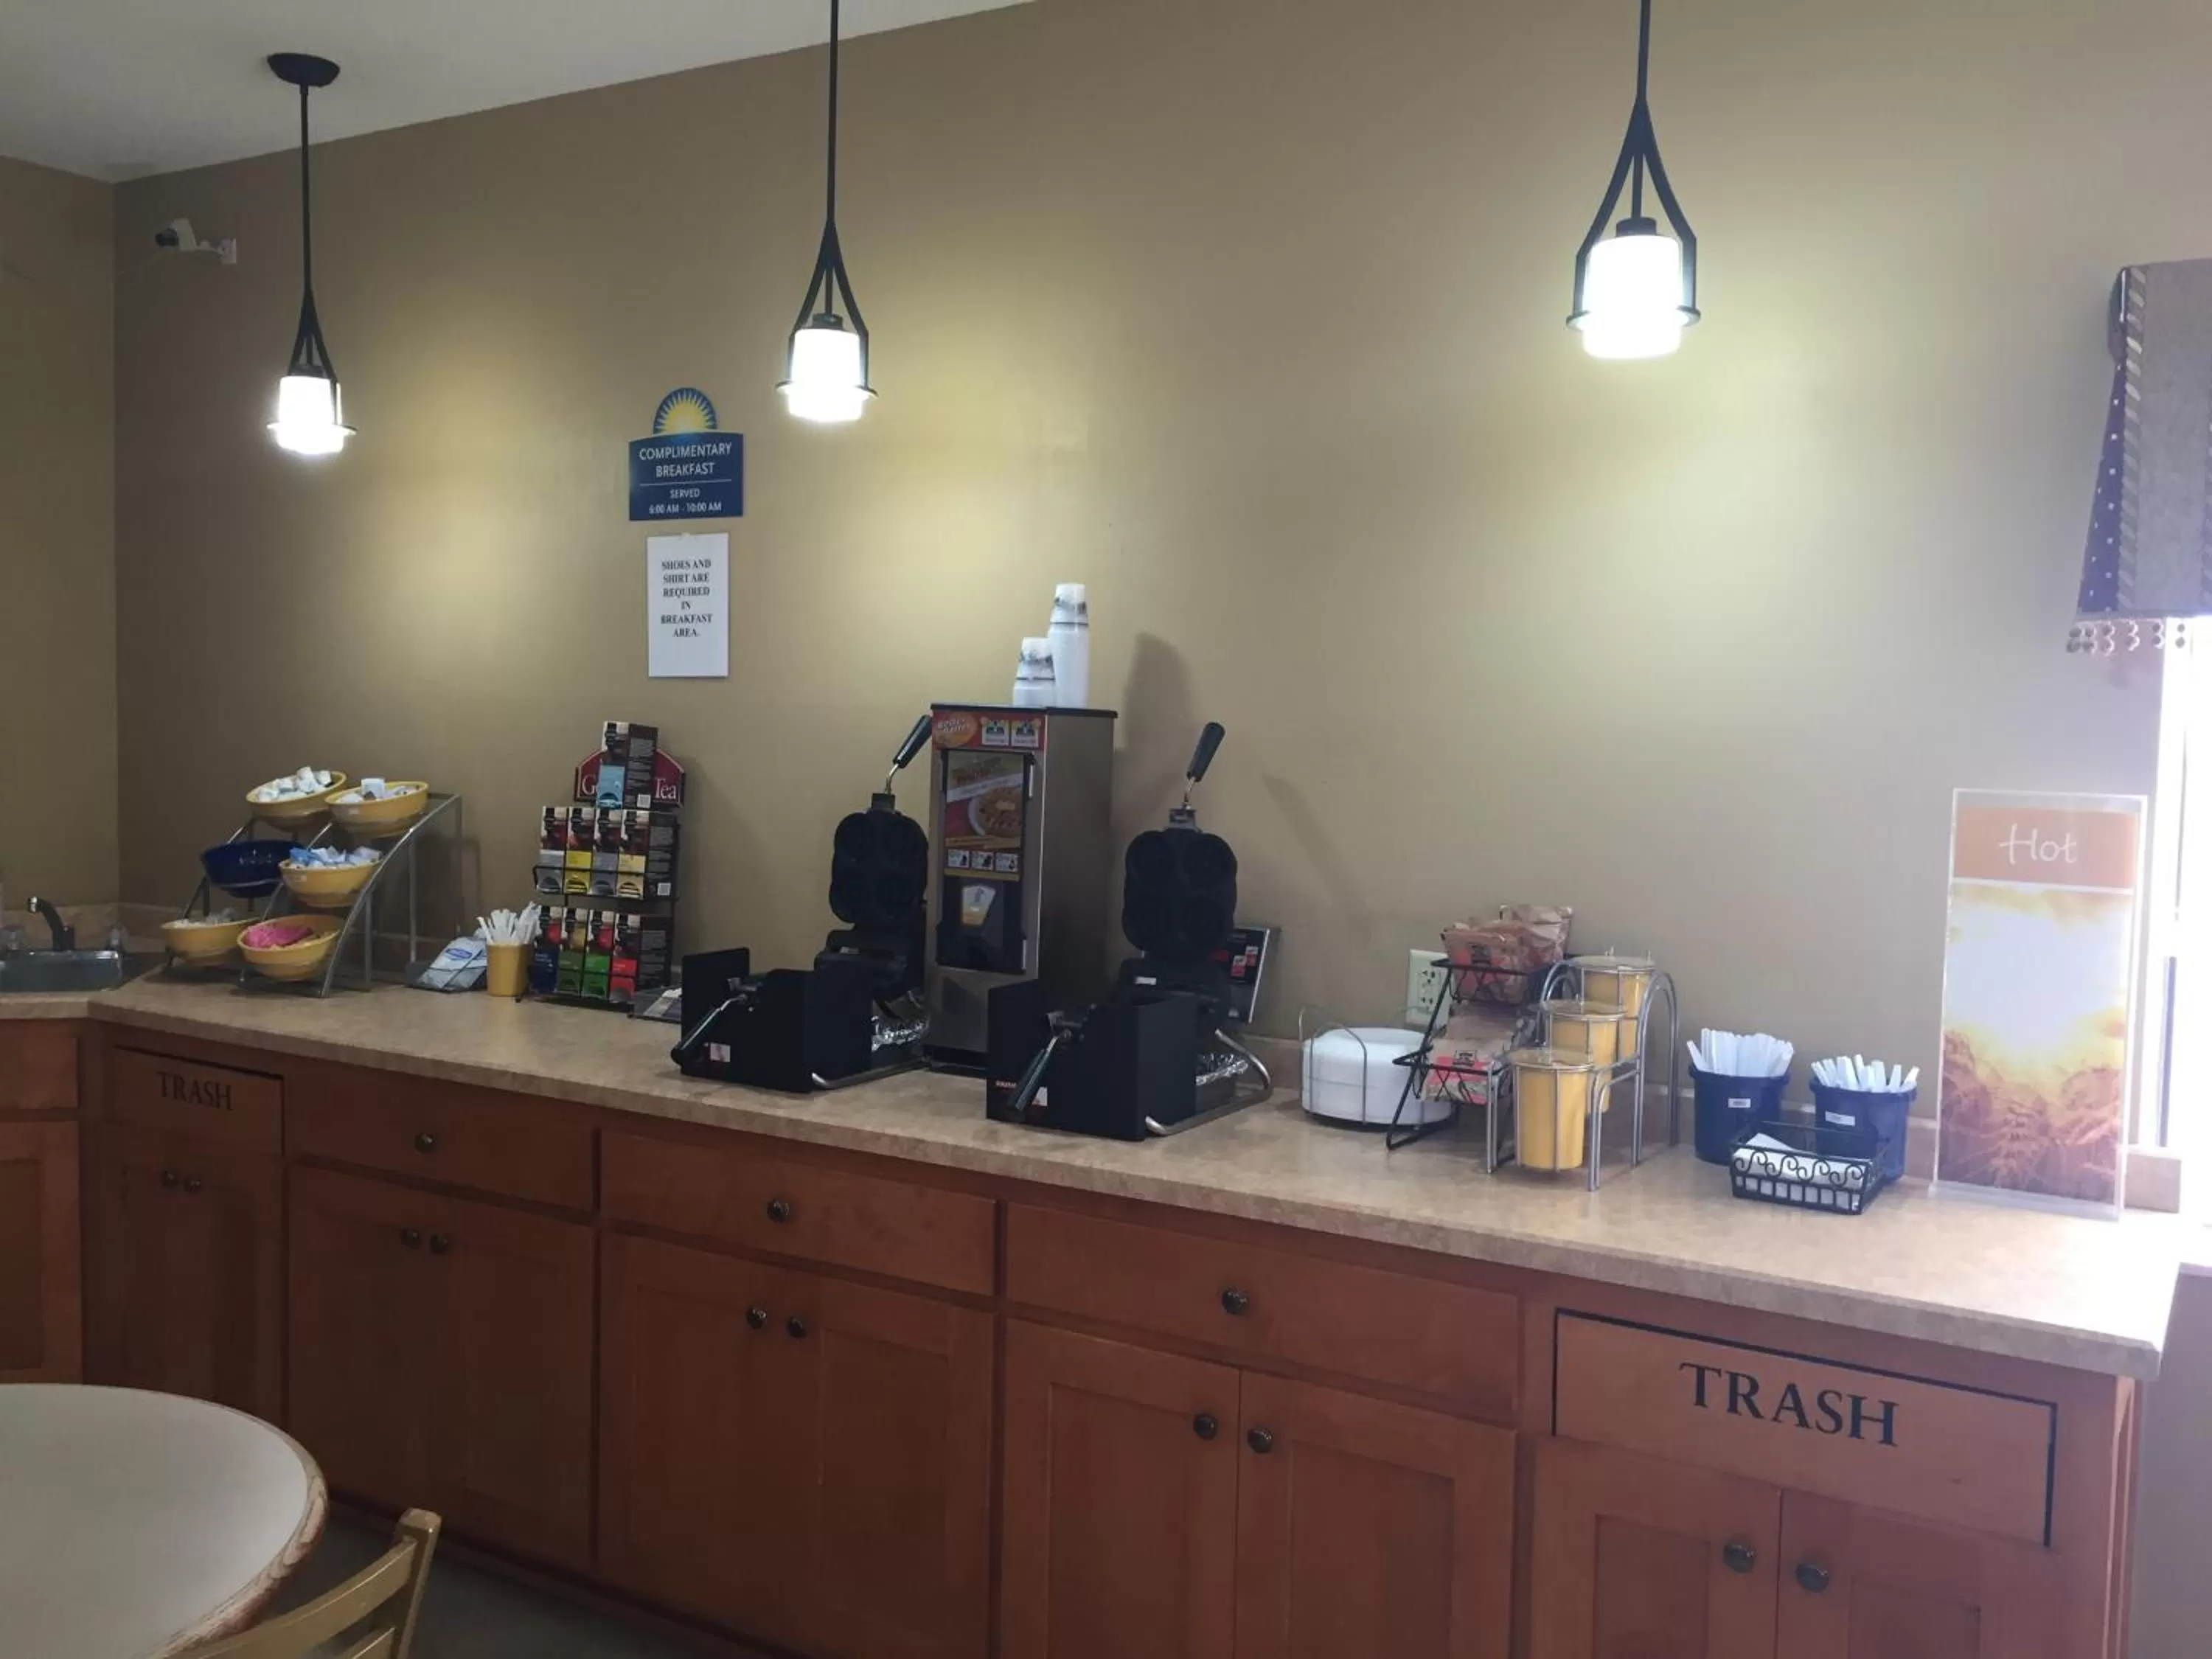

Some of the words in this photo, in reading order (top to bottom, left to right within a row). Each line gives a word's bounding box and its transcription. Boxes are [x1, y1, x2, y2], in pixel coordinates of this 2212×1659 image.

[639, 442, 732, 460] COMPLIMENTARY
[655, 462, 715, 478] BREAKFAST
[669, 488, 700, 499] SERVED
[666, 504, 679, 513] AM
[687, 502, 706, 512] 10:00
[708, 501, 722, 511] AM
[661, 560, 691, 570] SHOES
[693, 559, 711, 568] AND
[663, 574, 690, 583] SHIRT
[692, 572, 709, 582] ARE
[663, 587, 710, 598] REQUIRED
[681, 601, 691, 610] IN
[661, 613, 713, 625] BREAKFAST
[654, 778, 676, 799] Tea
[1999, 823, 2077, 865] Hot
[156, 1071, 235, 1111] TRASH
[1678, 1363, 1899, 1447] TRASH
